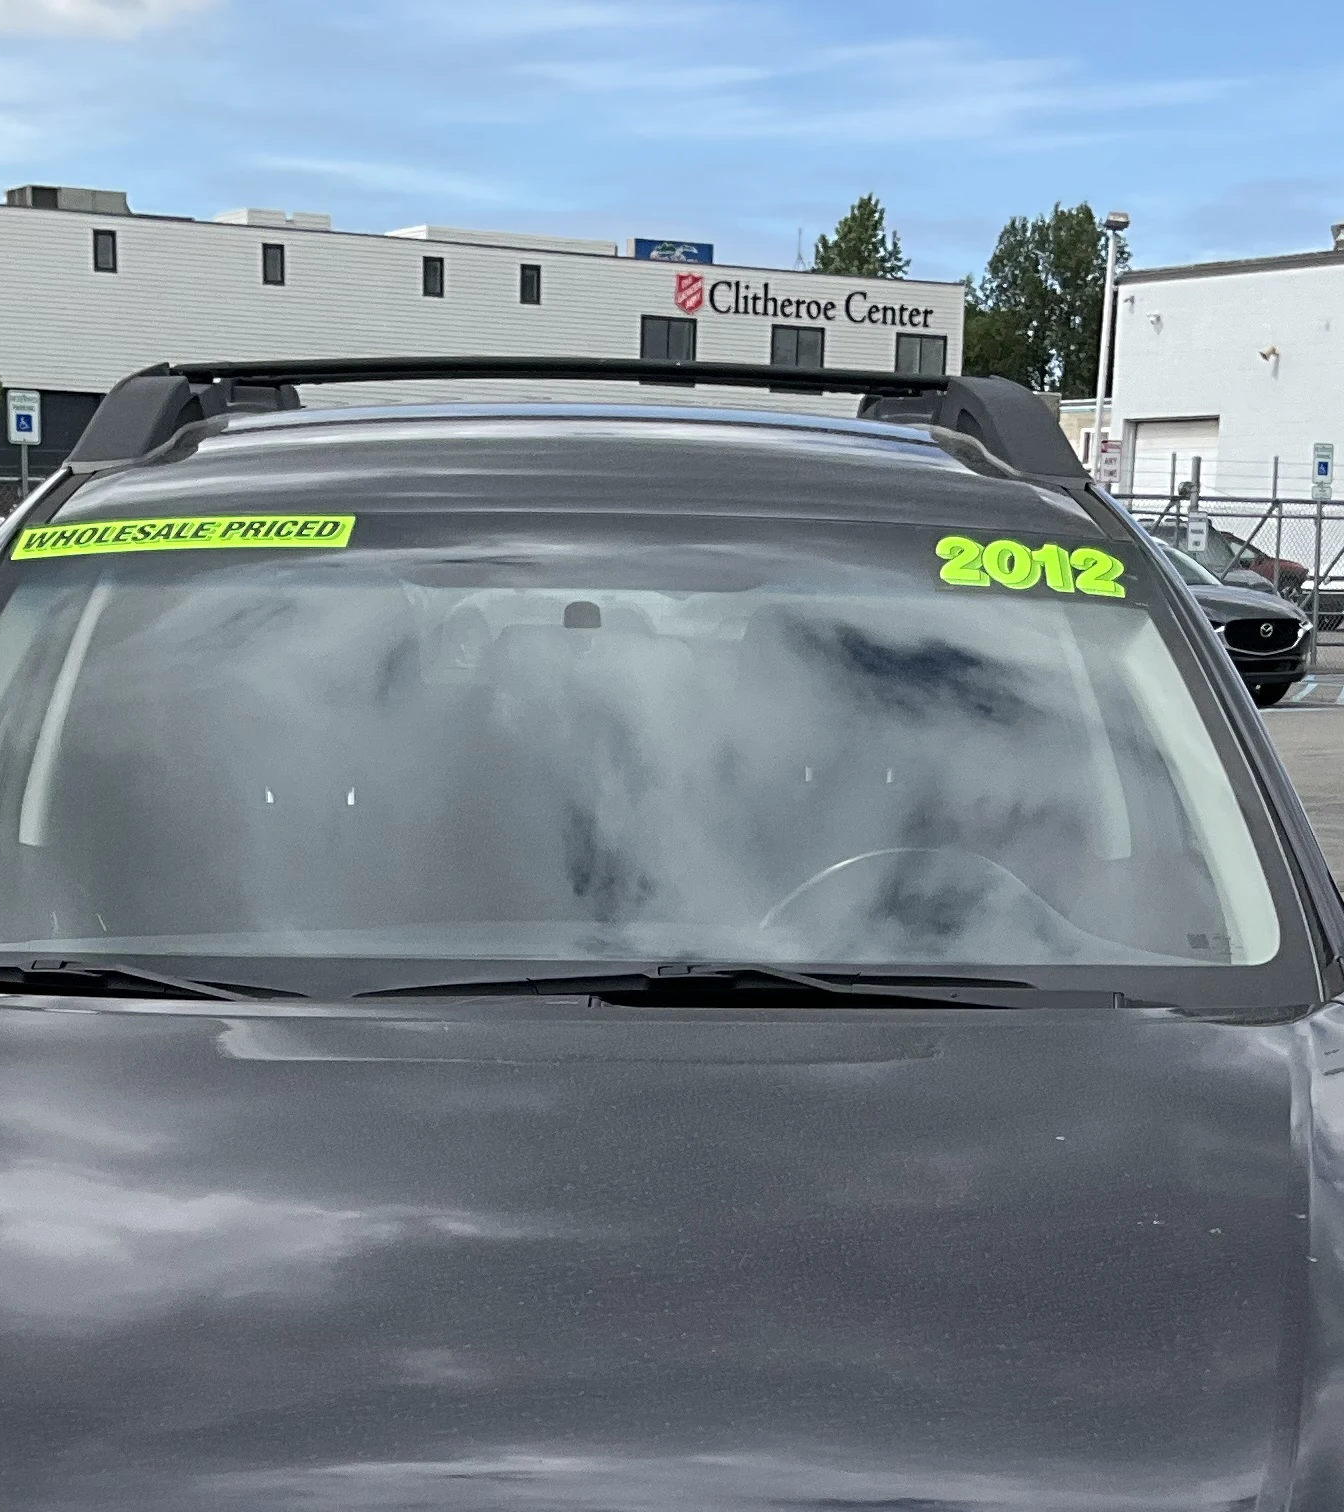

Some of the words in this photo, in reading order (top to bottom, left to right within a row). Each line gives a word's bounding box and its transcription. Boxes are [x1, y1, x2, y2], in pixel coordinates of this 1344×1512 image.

[709, 280, 837, 320] Clitheroe
[845, 291, 934, 328] Center
[22, 521, 215, 552] WHOLESALE
[221, 519, 346, 541] PRICED
[935, 536, 1126, 598] 2012
